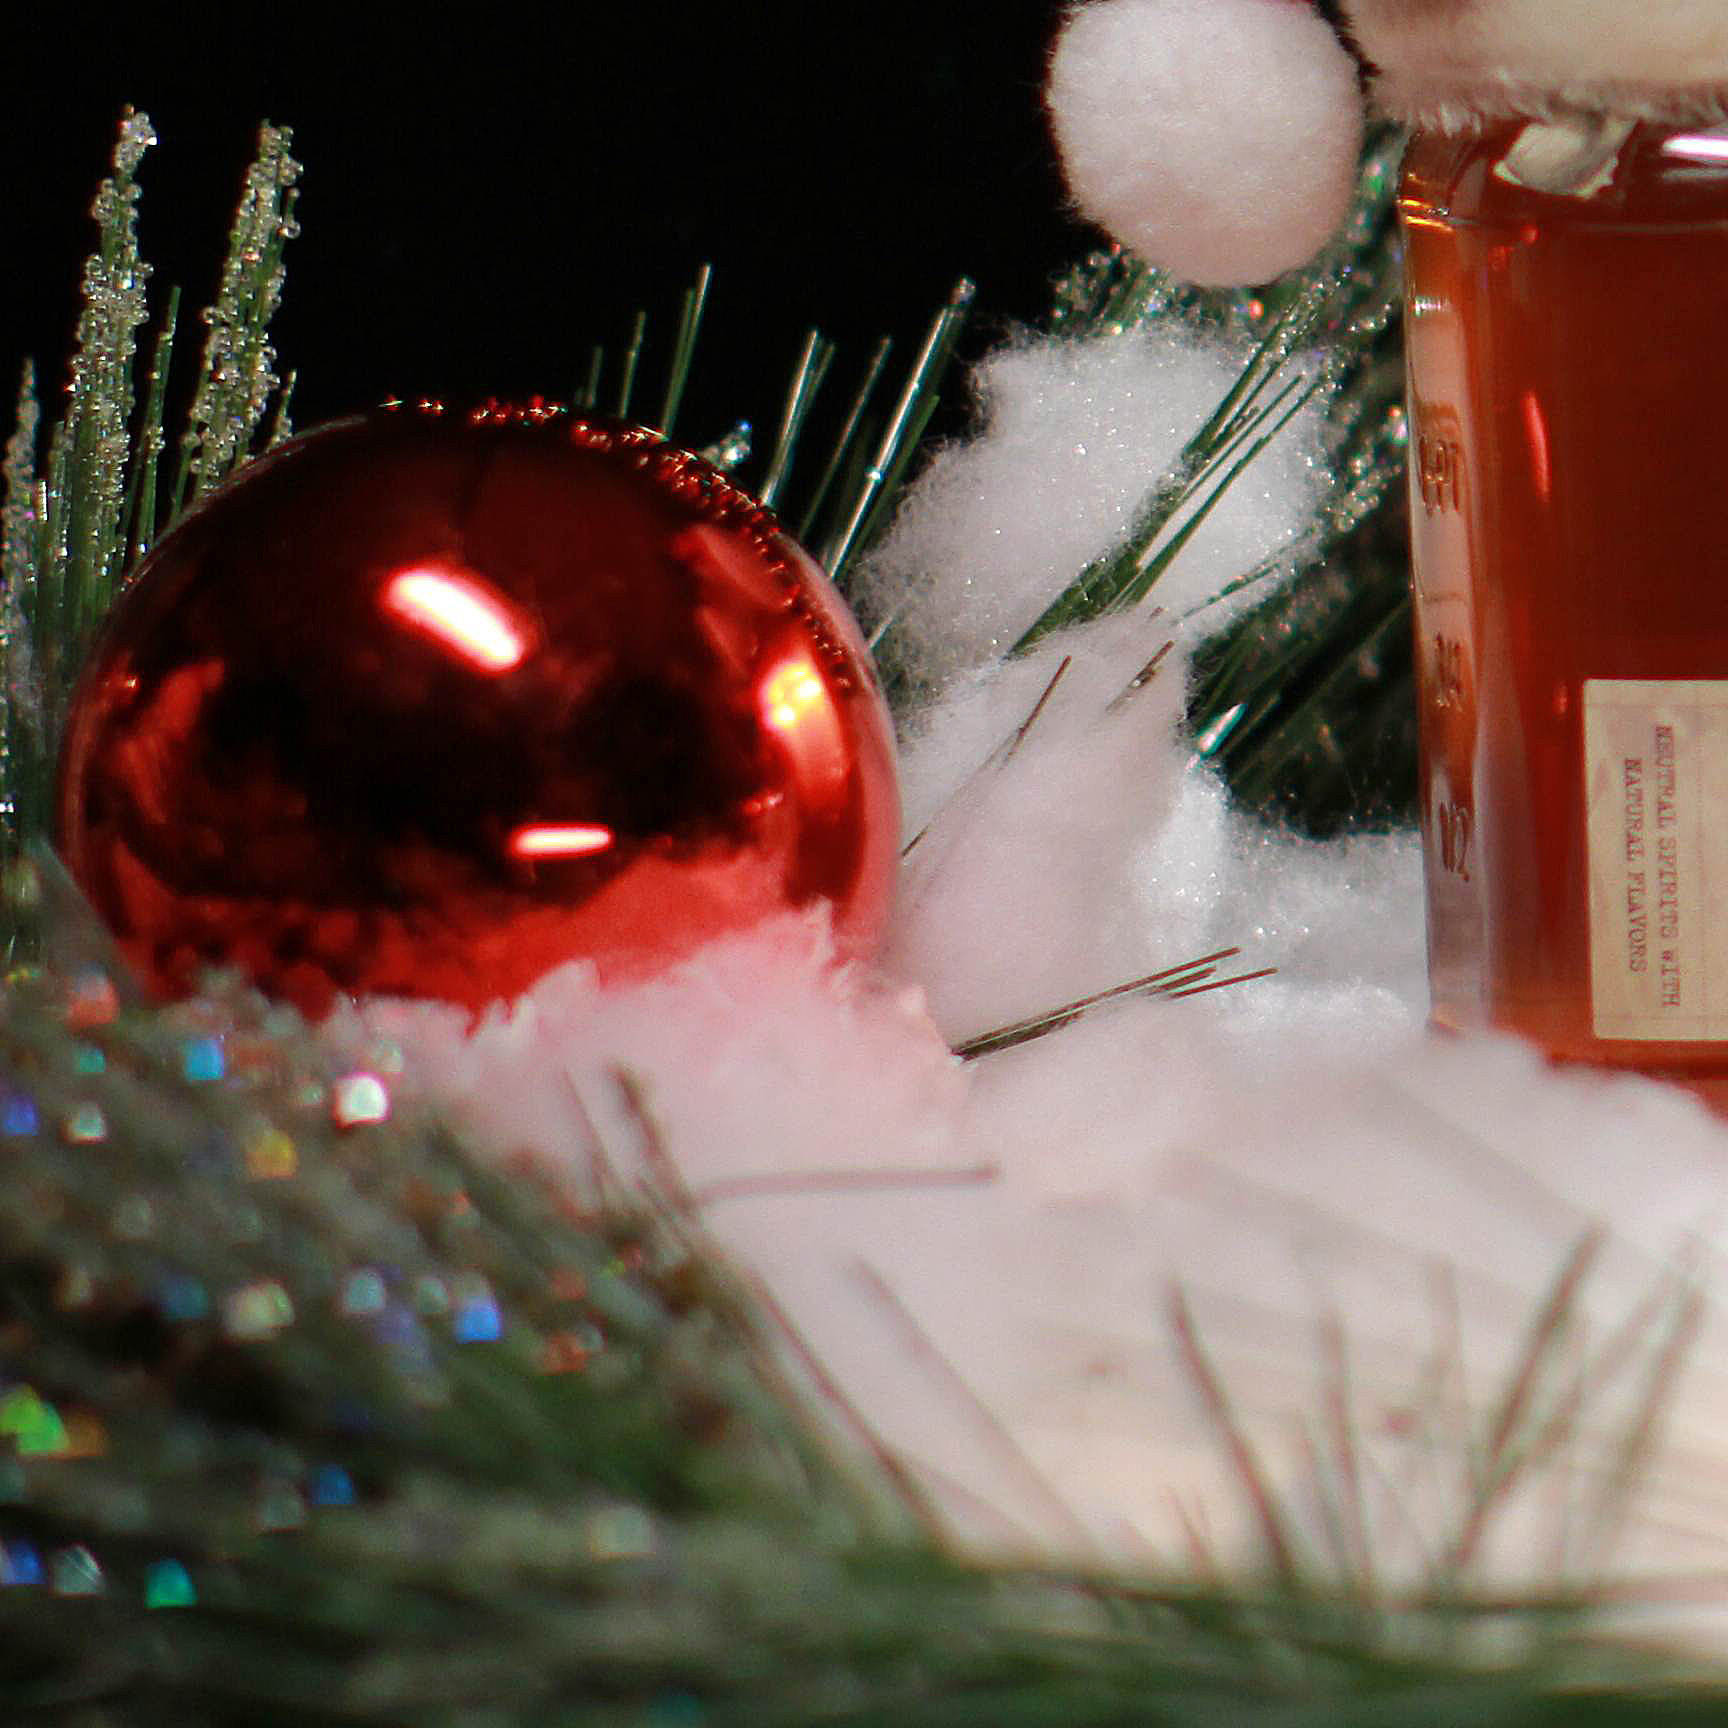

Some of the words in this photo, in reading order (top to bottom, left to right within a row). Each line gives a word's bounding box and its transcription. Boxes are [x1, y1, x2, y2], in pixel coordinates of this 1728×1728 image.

[1623, 757, 1645, 862] NATURAL
[1655, 725, 1677, 829] NEUTRAL
[1627, 872, 1649, 973] FLAVORS
[1658, 837, 1678, 939] SPIRITS
[1661, 949, 1681, 1007] WITH
